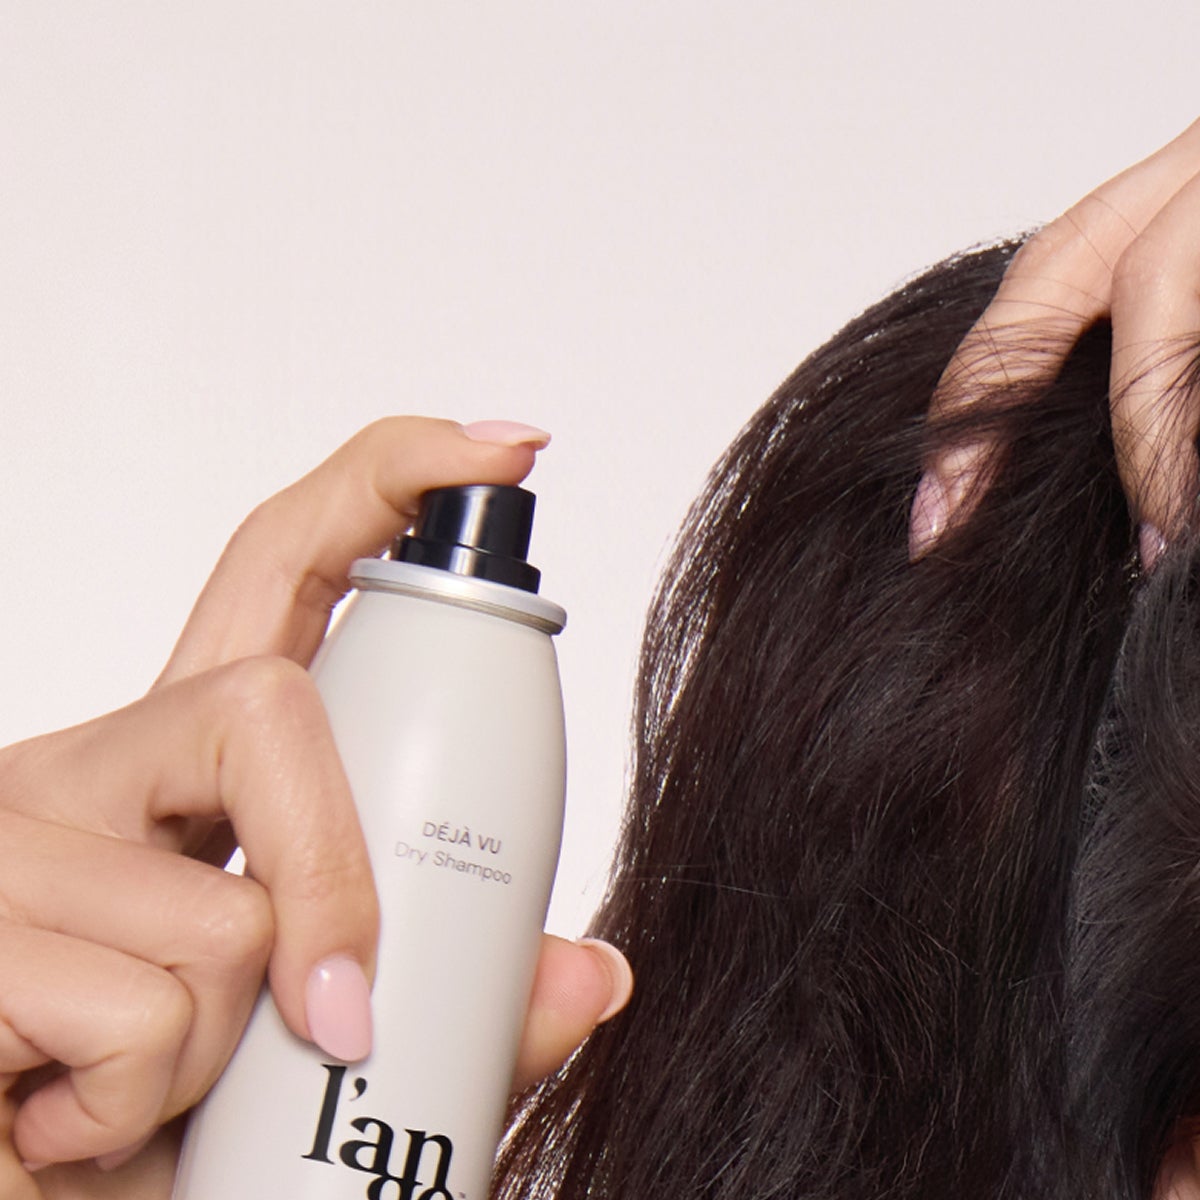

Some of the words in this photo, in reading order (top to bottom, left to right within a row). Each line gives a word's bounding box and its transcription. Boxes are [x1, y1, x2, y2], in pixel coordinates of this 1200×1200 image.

[422, 821, 471, 847] DÉJÀ
[478, 834, 502, 854] VU
[394, 841, 428, 865] Dry
[433, 850, 512, 885] Shampoo
